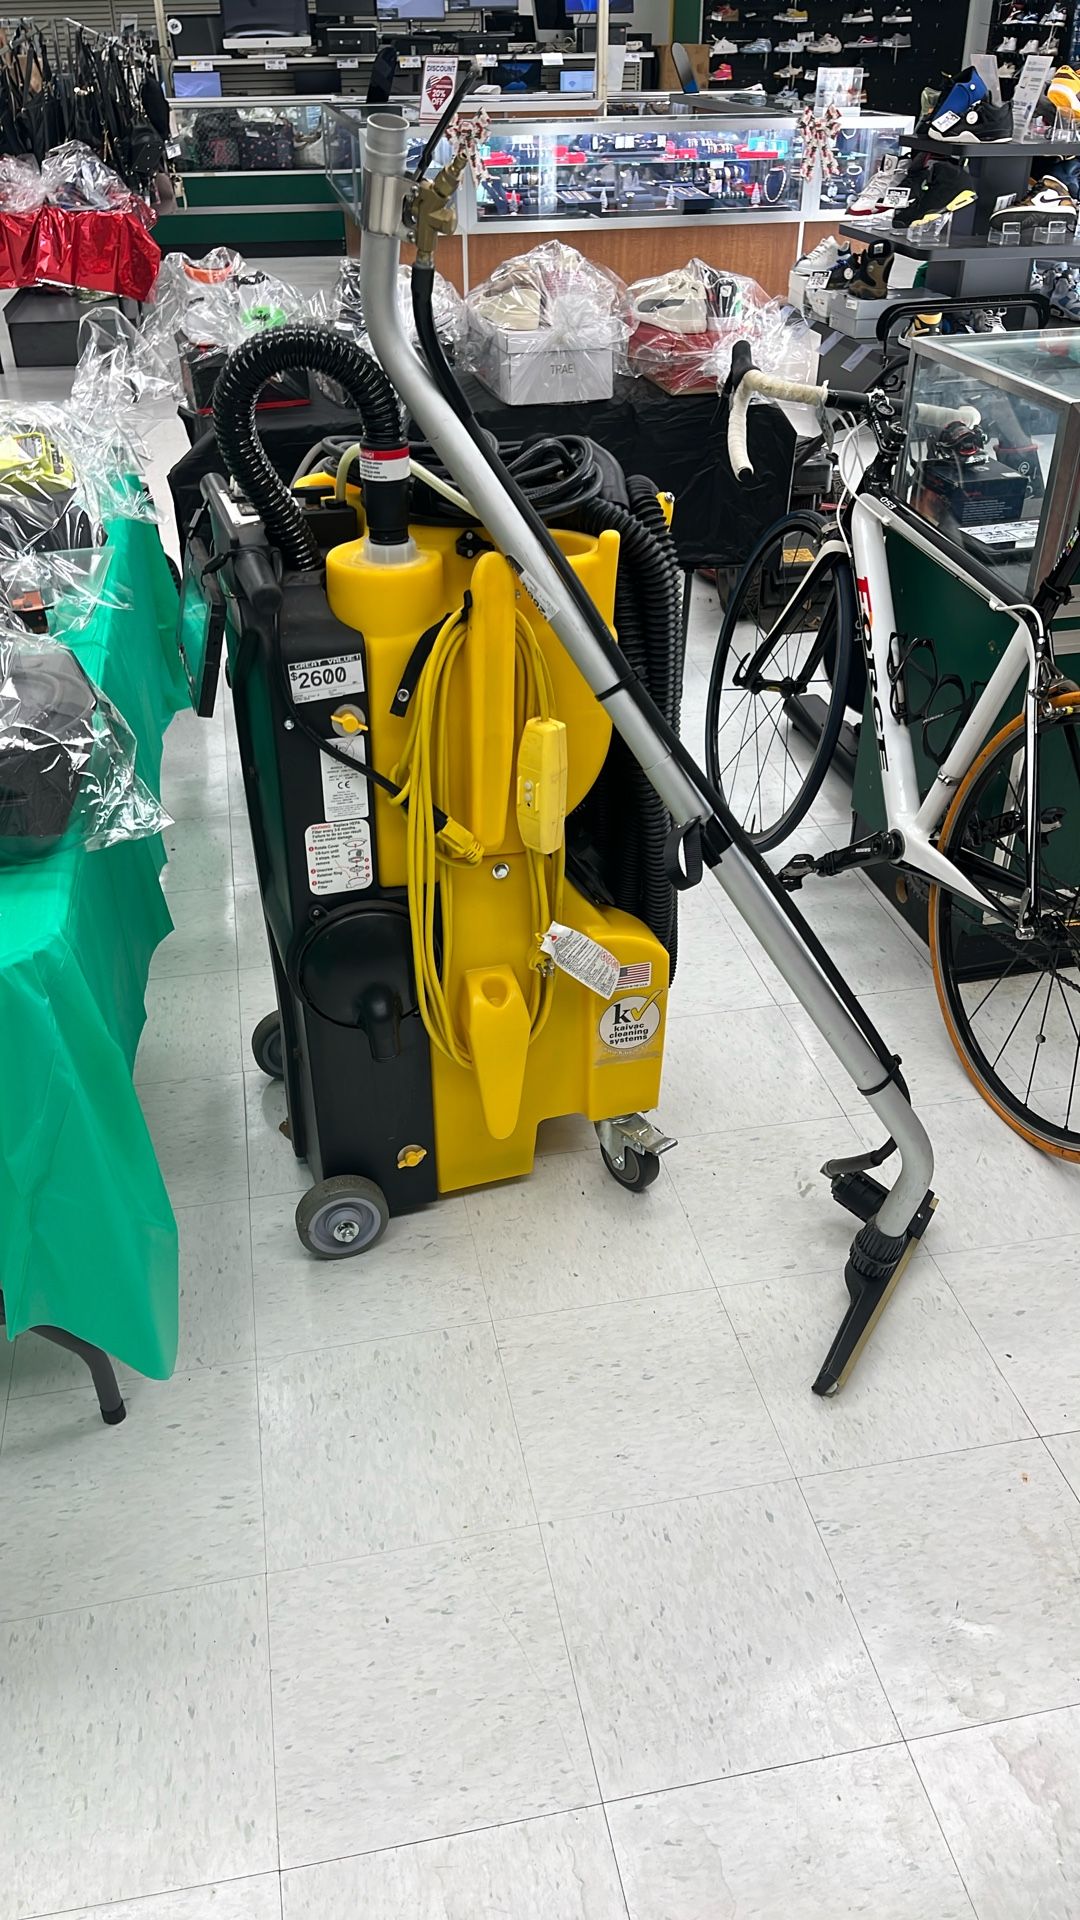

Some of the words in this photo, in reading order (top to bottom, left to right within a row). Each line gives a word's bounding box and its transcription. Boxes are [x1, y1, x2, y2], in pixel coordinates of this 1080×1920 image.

[294, 660, 321, 670] GREAT
[327, 654, 360, 665] VALUE!
[290, 666, 347, 690] $2600
[857, 576, 889, 772] FORCE
[612, 1003, 631, 1025] k
[609, 1028, 649, 1039] cleaning
[614, 1023, 645, 1032] kaivac
[609, 1034, 648, 1045] systems
